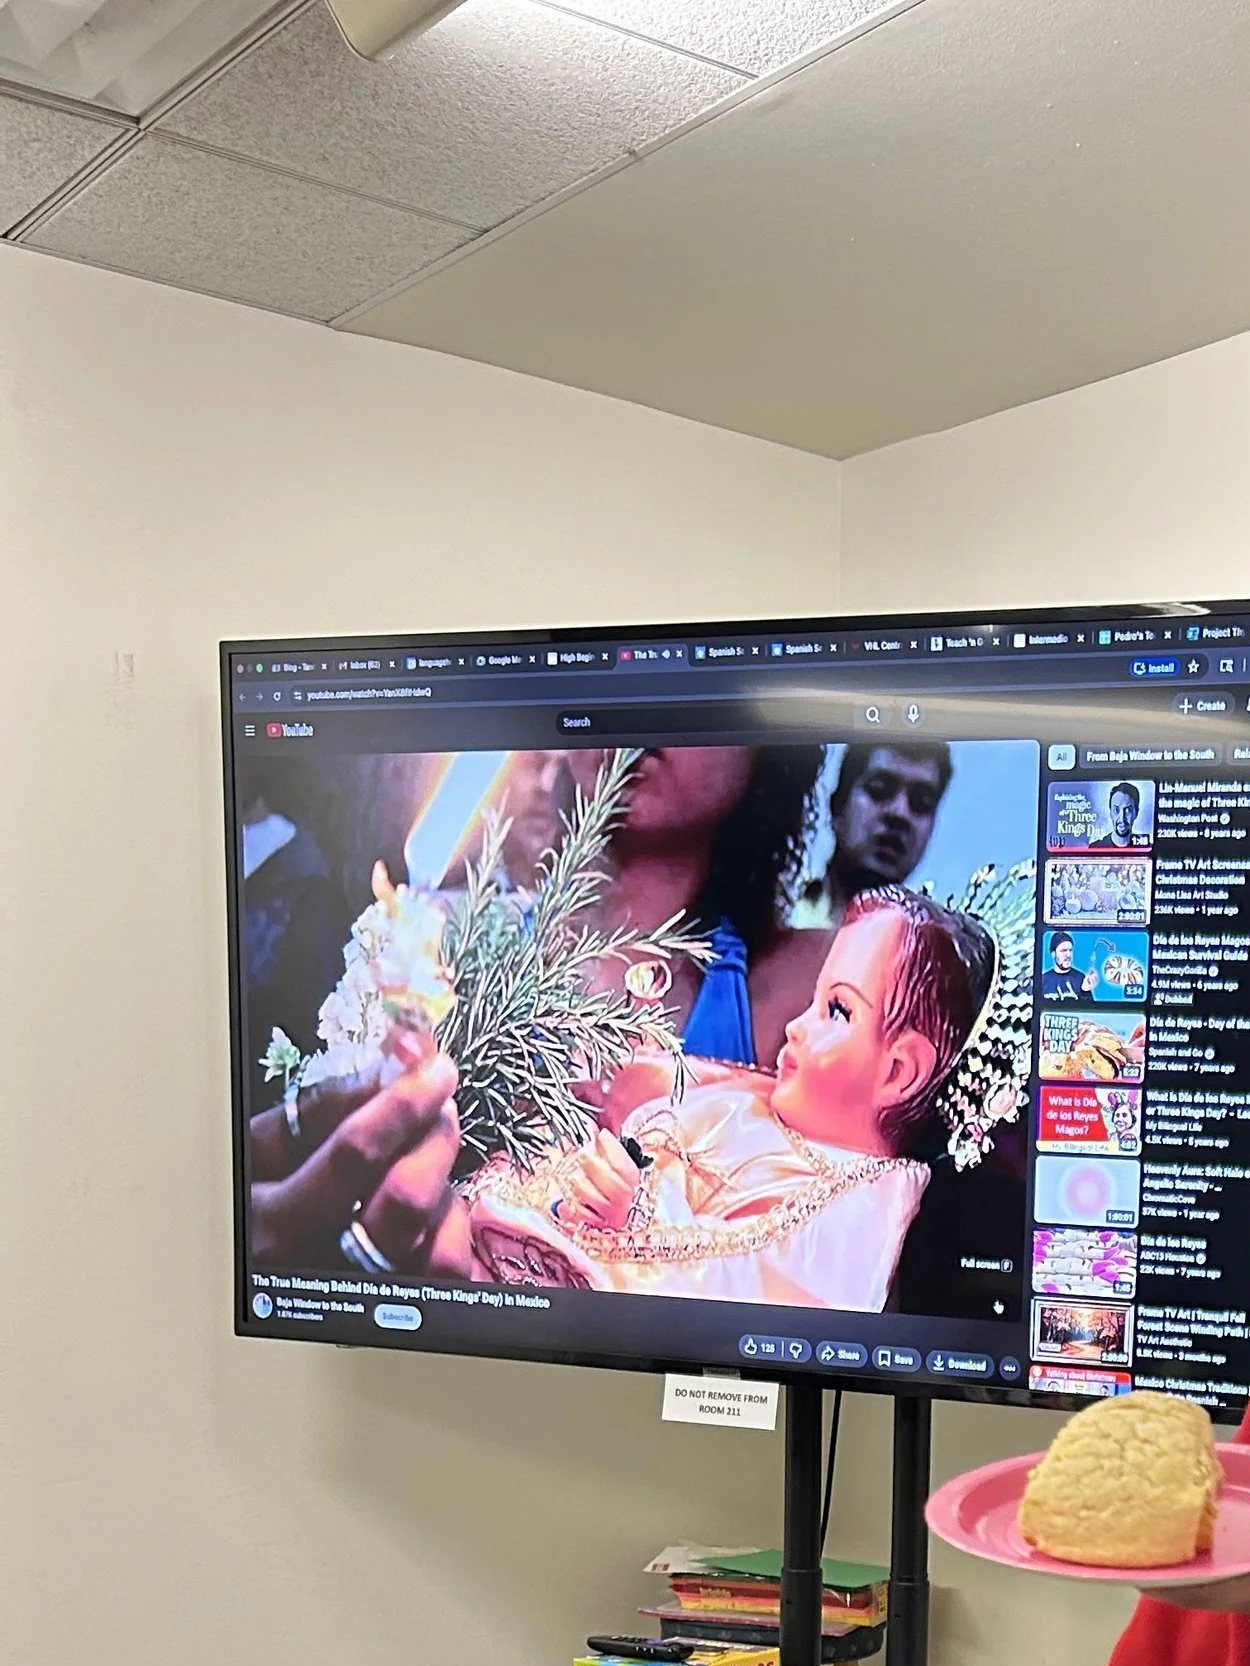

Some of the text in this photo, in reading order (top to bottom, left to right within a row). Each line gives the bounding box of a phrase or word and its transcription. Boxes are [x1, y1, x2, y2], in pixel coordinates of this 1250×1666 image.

[1148, 662, 1175, 674] Install
[1196, 700, 1226, 712] Create
[562, 716, 591, 728] Search
[282, 723, 314, 737] YouTube
[1056, 751, 1067, 762] All
[1086, 749, 1215, 764] From Baja Window to the South
[1057, 820, 1086, 837] Kings
[1184, 859, 1197, 871] TV
[1197, 859, 1211, 871] Art
[1044, 1015, 1078, 1030] THREE
[1165, 1017, 1176, 1028] de
[1208, 1018, 1225, 1032] Day
[1226, 1018, 1236, 1030] of
[1236, 1018, 1250, 1030] the
[1044, 1027, 1078, 1041] KINGS
[1158, 1032, 1189, 1043] Mexico
[1050, 1040, 1074, 1054] DAY
[1048, 1095, 1098, 1108] What is Día
[1046, 1110, 1099, 1124] de los Reyes
[1206, 1107, 1227, 1120] Day?
[1055, 1124, 1089, 1137] Magos?
[1143, 1163, 1181, 1177] Heavenly
[1204, 1166, 1223, 1177] Soft
[961, 1258, 974, 1269] Full
[975, 1259, 1000, 1270] screen
[252, 1274, 270, 1287] The
[271, 1276, 291, 1289] True
[291, 1278, 330, 1293] Meaning
[330, 1281, 362, 1294] Behind
[363, 1282, 378, 1295] Día
[379, 1284, 392, 1296] de
[393, 1285, 420, 1300] Reyes
[421, 1286, 451, 1302] (Three
[481, 1291, 504, 1307] Day)
[504, 1293, 514, 1306] in
[515, 1294, 551, 1309] Mexico
[293, 1298, 321, 1310] Window
[321, 1300, 330, 1311] to
[330, 1301, 343, 1312] the
[343, 1302, 365, 1314] South
[837, 1349, 860, 1361] Share
[894, 1354, 914, 1366] Save
[948, 1358, 987, 1372] Download
[675, 1388, 768, 1404] DO NOT REMOVE FROM
[699, 1404, 742, 1417] ROOM 211
